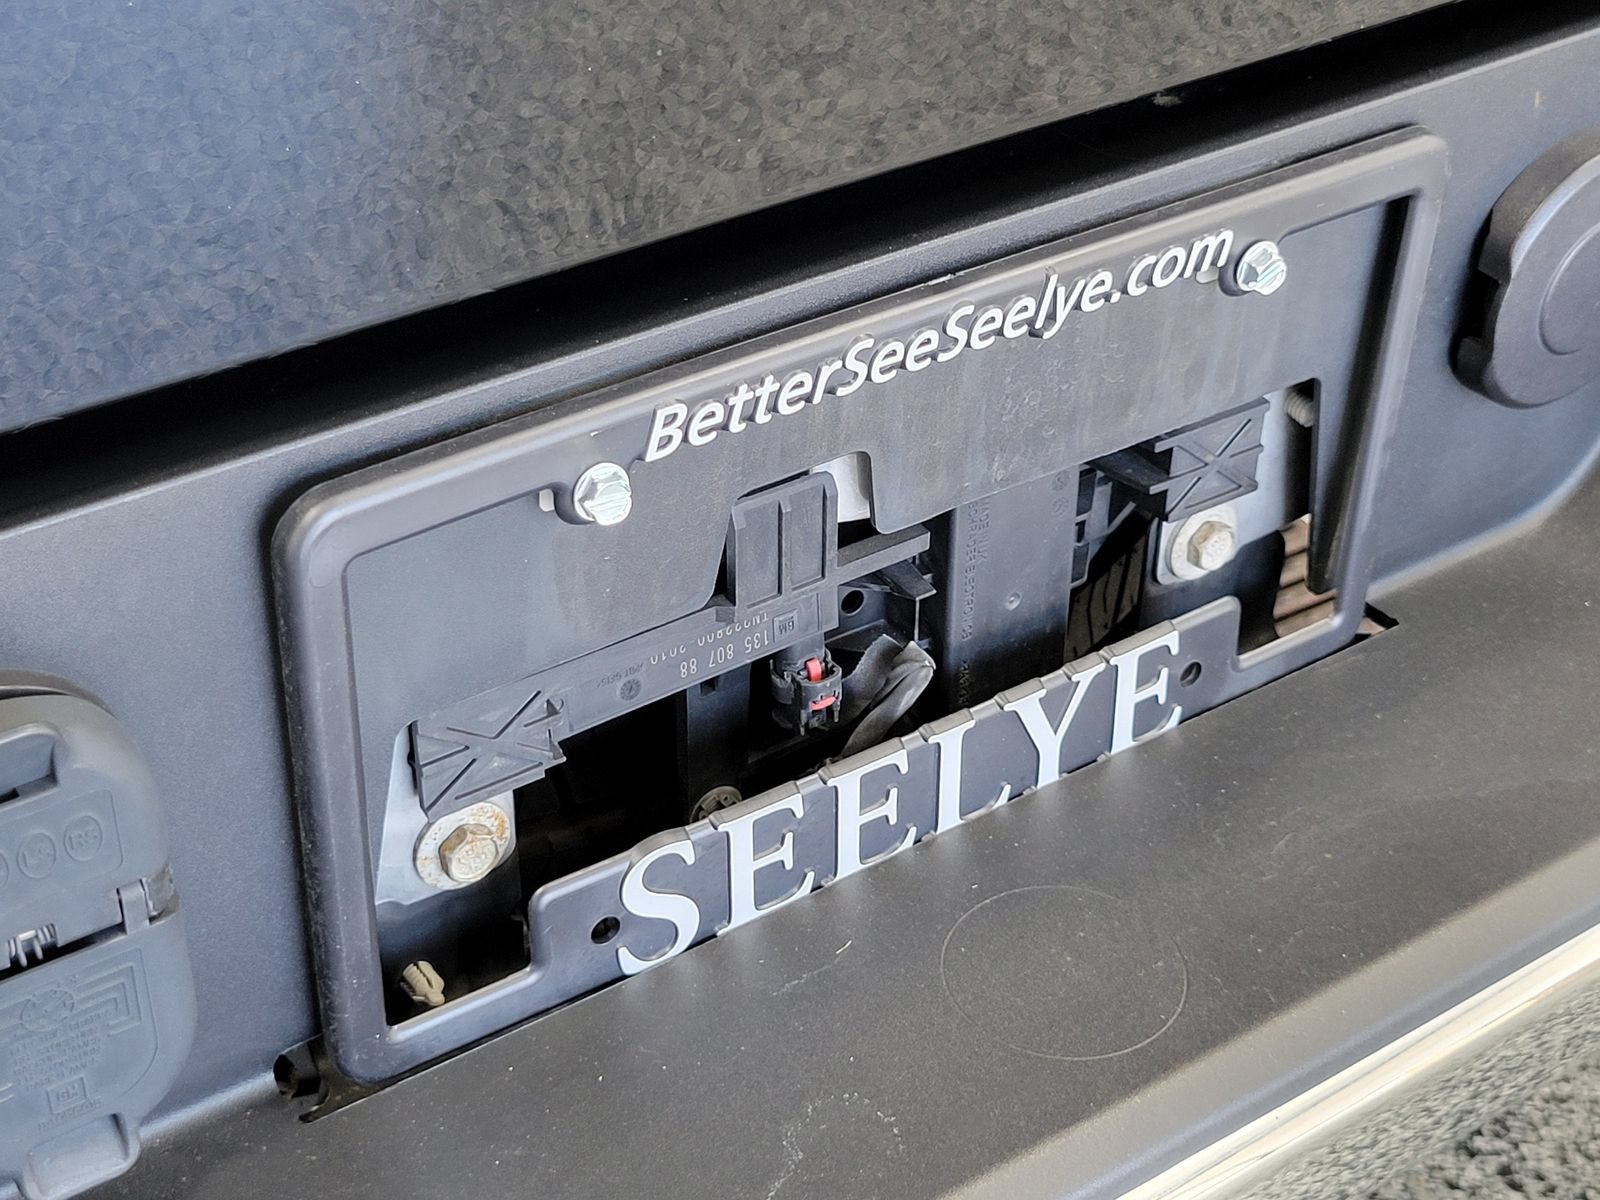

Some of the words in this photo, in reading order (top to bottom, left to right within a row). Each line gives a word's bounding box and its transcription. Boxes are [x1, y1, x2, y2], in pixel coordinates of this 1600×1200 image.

[643, 229, 1236, 463] BetterSeeSeelye.com
[745, 630, 769, 654] 135
[708, 644, 734, 668] 807
[680, 658, 698, 679] 88
[617, 631, 1183, 976] SEELYE
